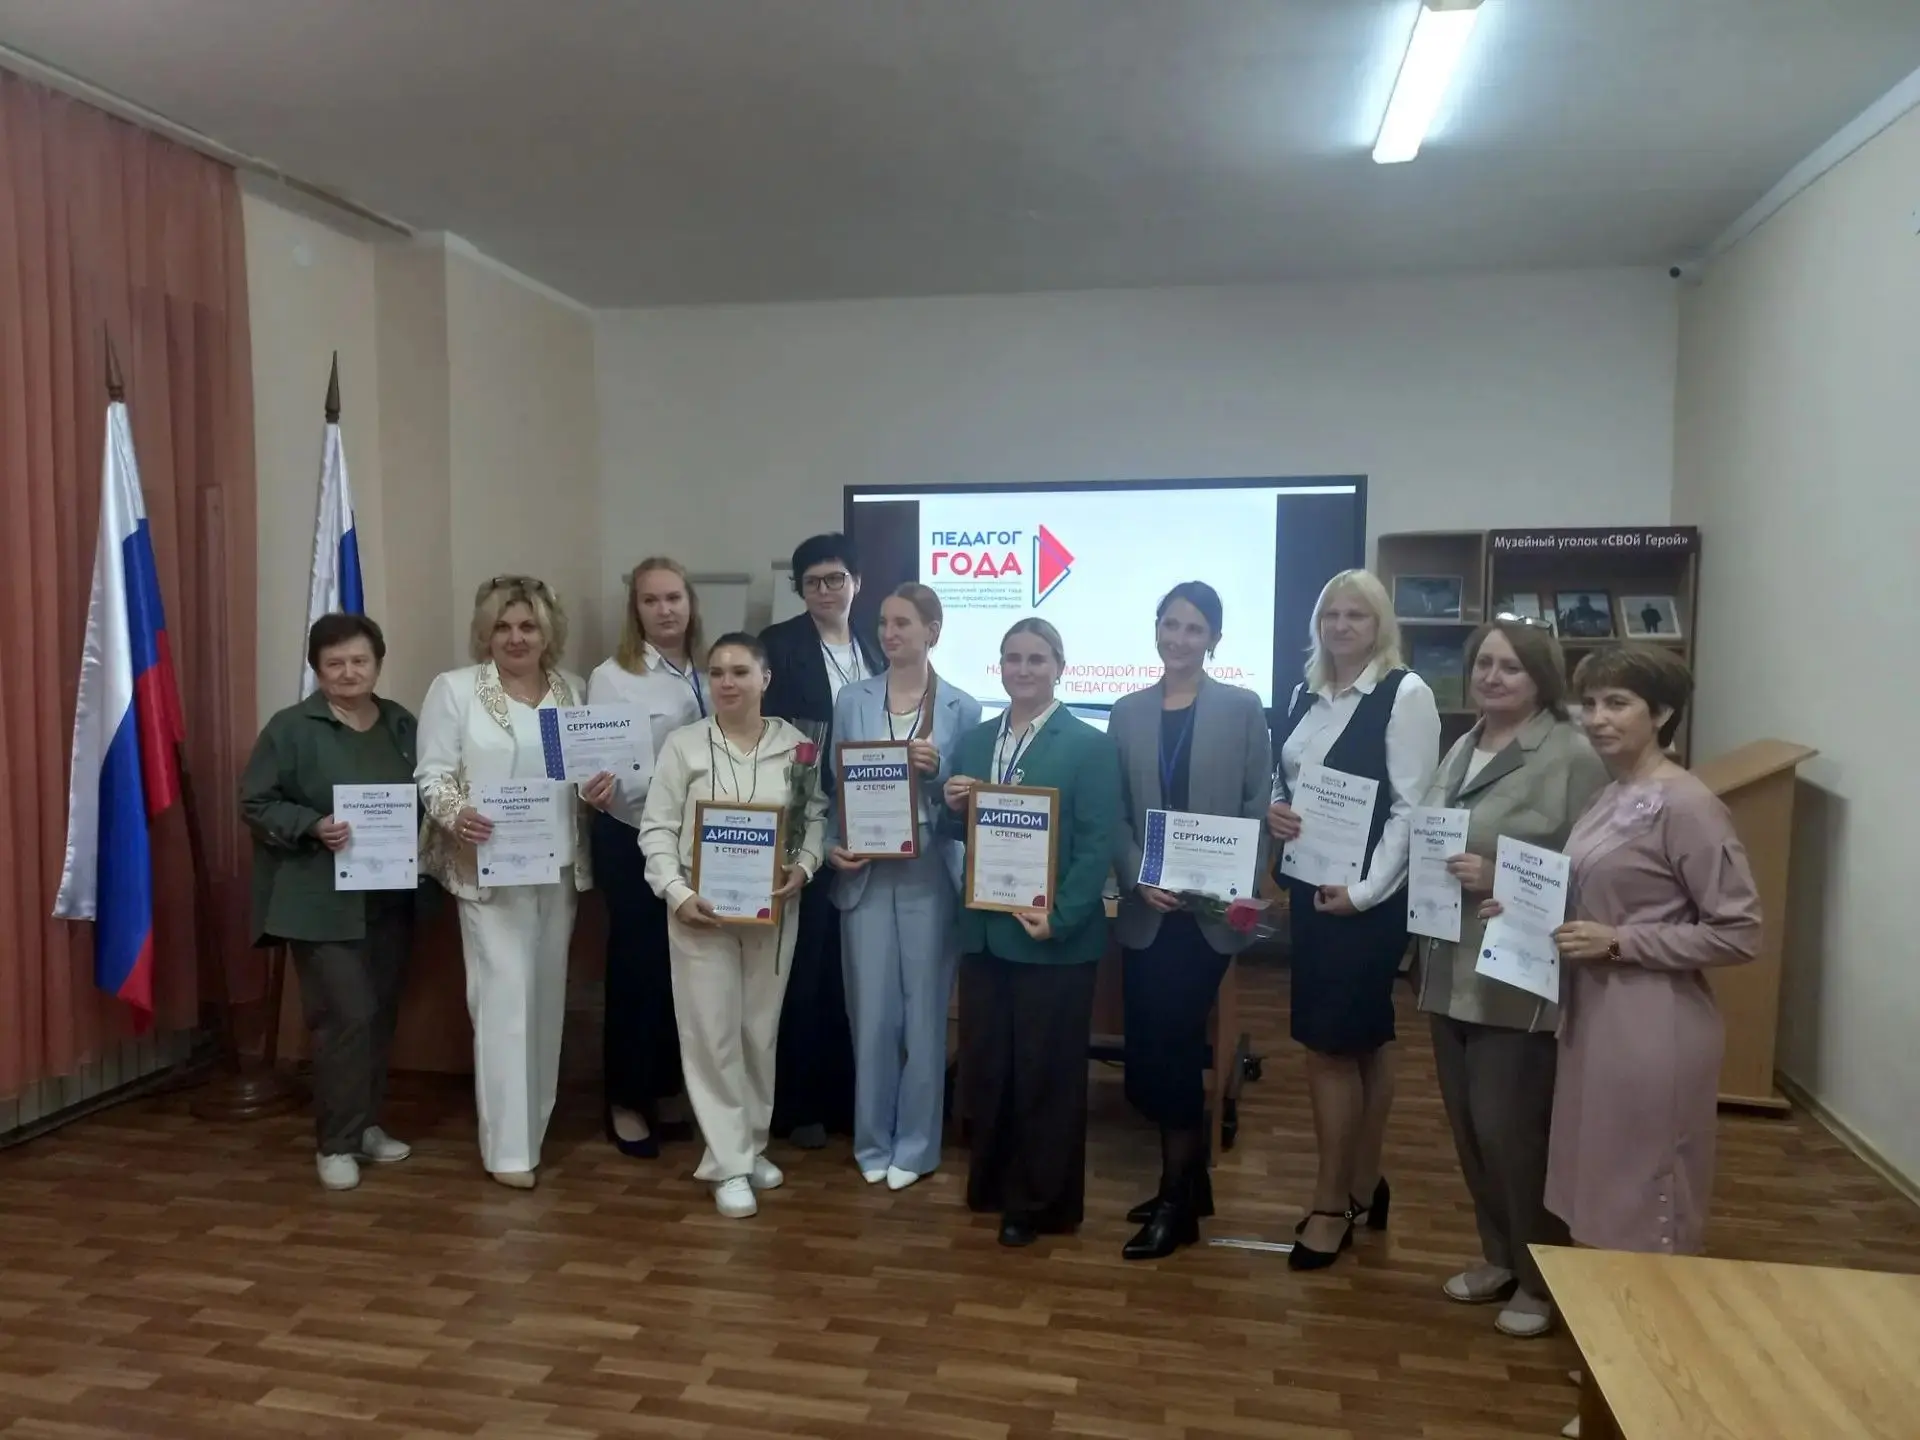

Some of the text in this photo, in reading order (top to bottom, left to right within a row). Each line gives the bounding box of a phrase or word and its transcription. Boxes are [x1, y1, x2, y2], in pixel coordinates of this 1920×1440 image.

[932, 531, 1022, 547] ПЕДАГОГ
[1494, 534, 1688, 550] Музейный уголок «СВОй Герой»
[932, 552, 1022, 579] ГОДА
[1065, 665, 1135, 678] МОЛОДОЙ
[567, 720, 631, 731] СЕРТИФИКАТ
[848, 767, 903, 780] ДИПЛОМ
[863, 783, 896, 791] СТЕПЕНИ
[1317, 795, 1345, 808] ПИСЬМО
[980, 811, 1042, 826] ДИПЛОМ
[706, 829, 769, 842] ДИПЛОМ
[995, 830, 1032, 840] СТЕПЕНИ
[1172, 832, 1239, 846] СЕРТИФИКАТ
[722, 846, 760, 856] СТЕПЕНИ
